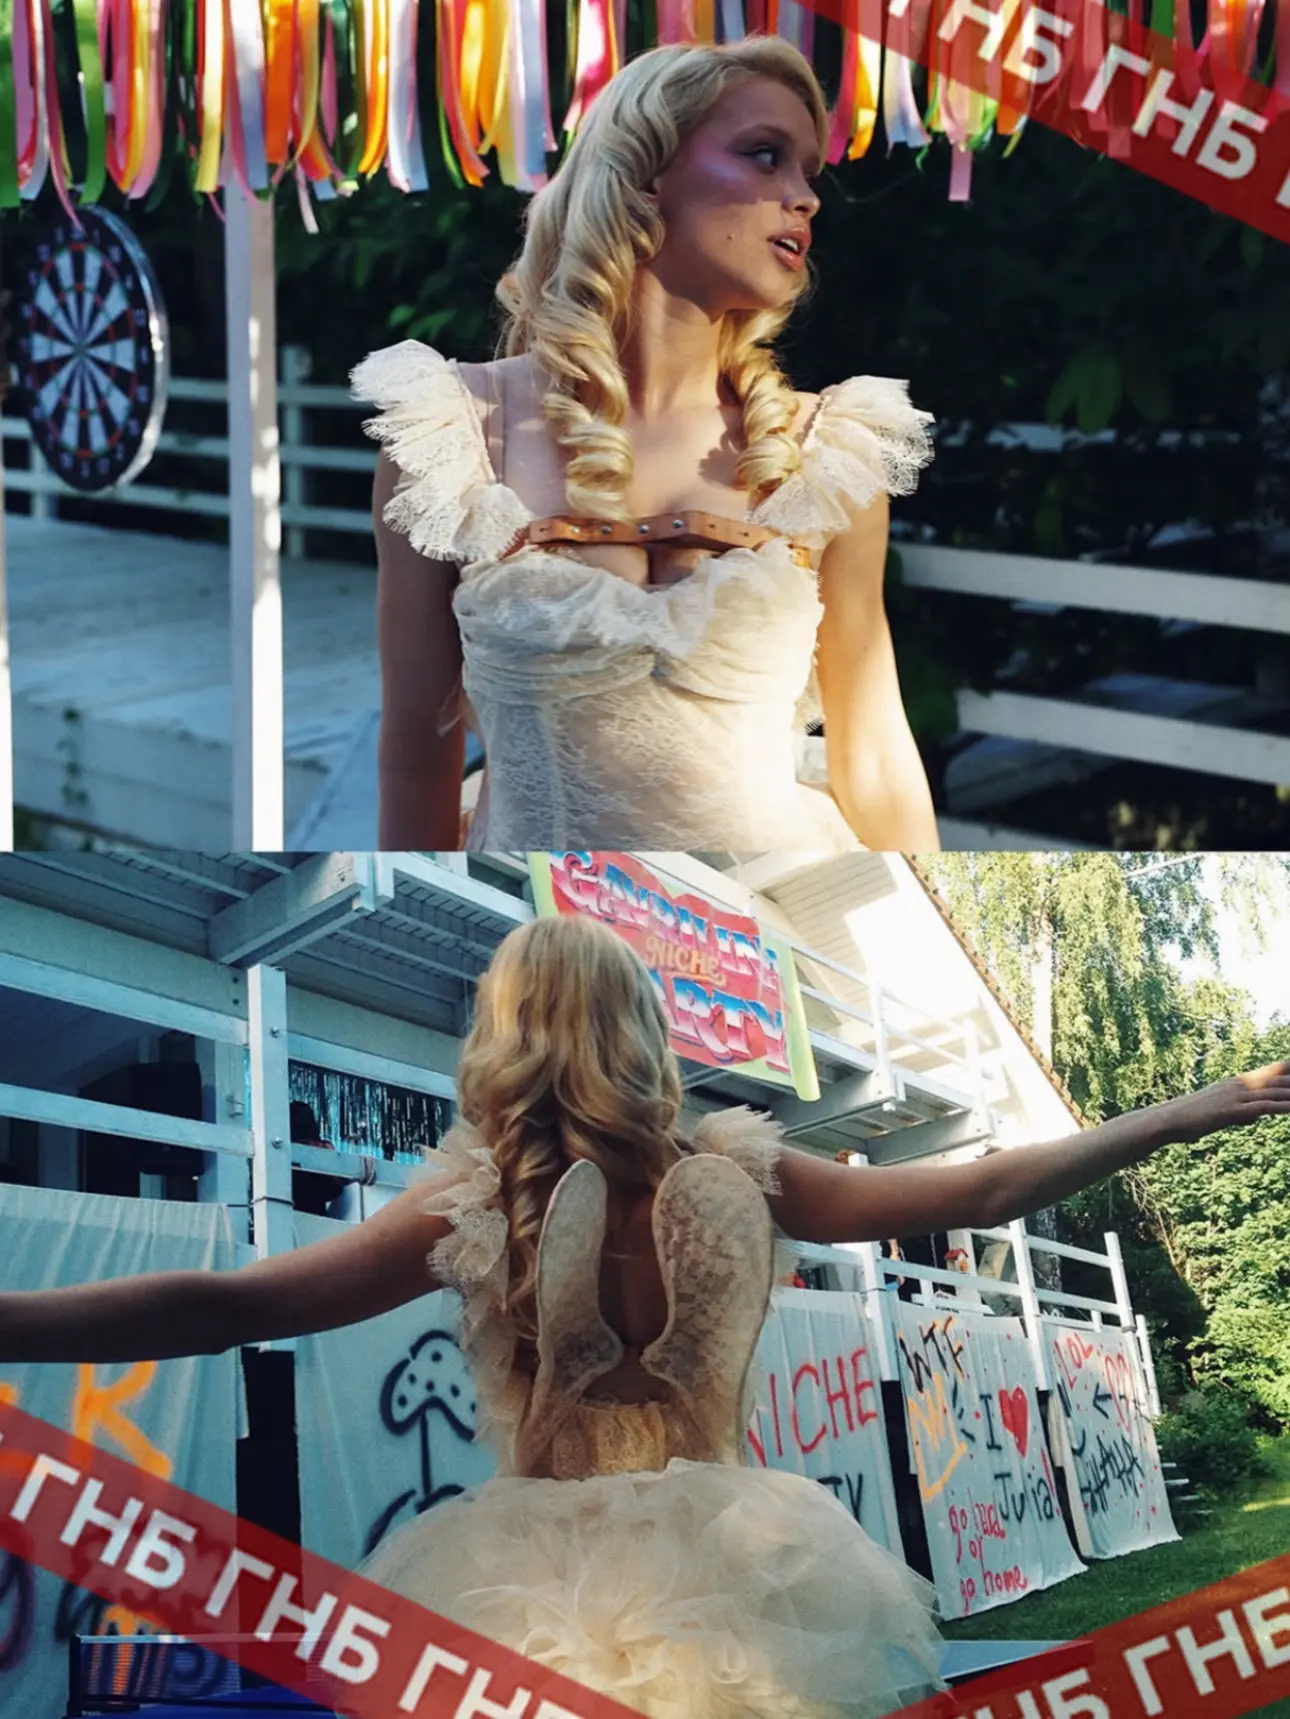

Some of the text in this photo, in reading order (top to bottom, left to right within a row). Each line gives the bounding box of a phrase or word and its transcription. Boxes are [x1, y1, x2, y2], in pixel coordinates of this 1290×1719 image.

[646, 936, 727, 987] NICHE
[899, 1316, 965, 1395] WTF
[1053, 1331, 1094, 1391] LOL
